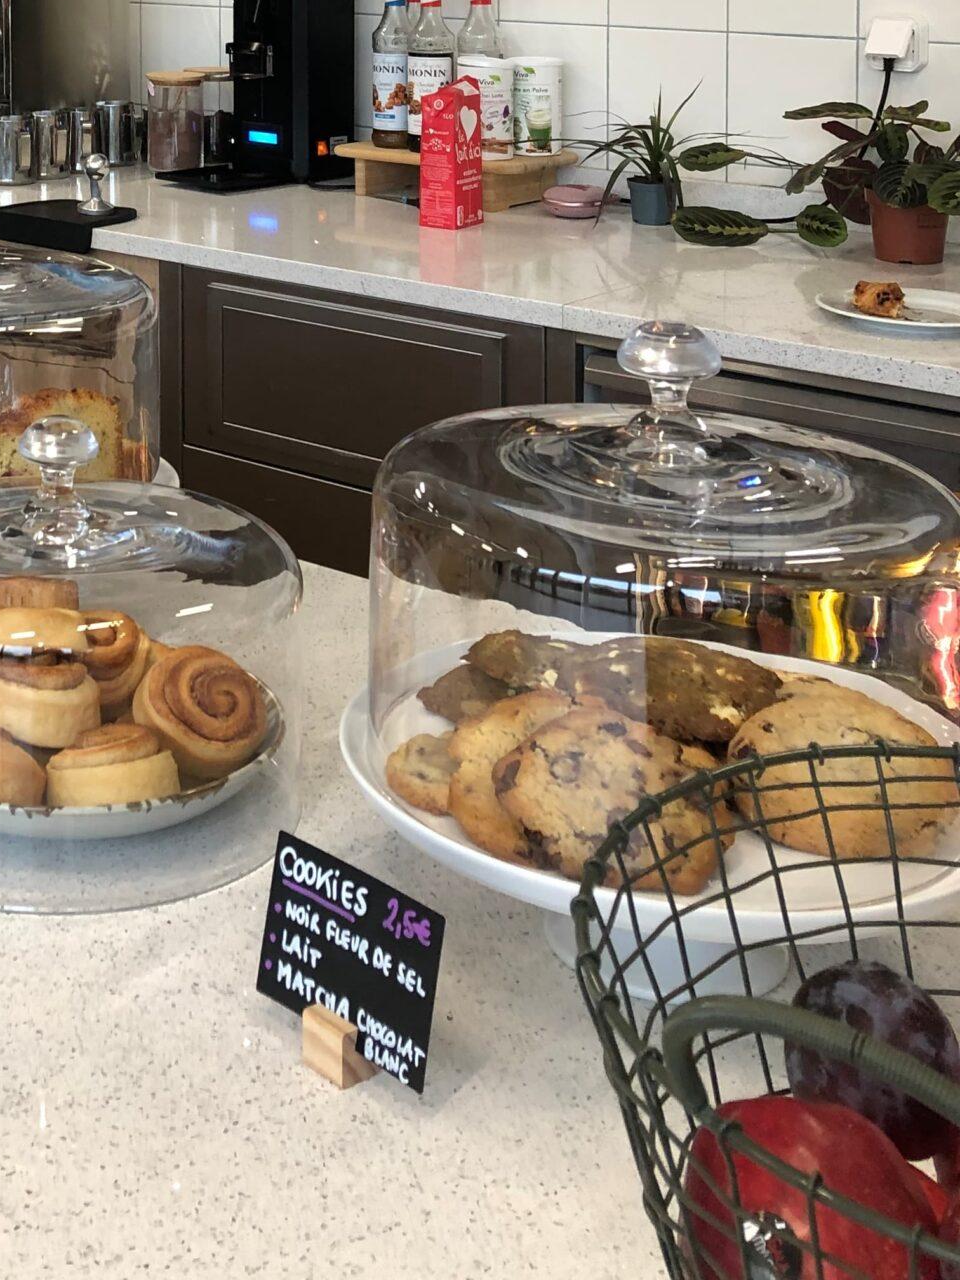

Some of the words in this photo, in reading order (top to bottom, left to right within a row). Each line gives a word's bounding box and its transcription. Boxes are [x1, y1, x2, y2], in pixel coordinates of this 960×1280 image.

[382, 897, 431, 947] 2,5€
[326, 919, 370, 965] FLEUR
[372, 945, 393, 977] DE
[396, 961, 426, 998] SEL
[277, 959, 350, 1021] MATCHA
[356, 1007, 427, 1068] CHOCOLAT
[363, 1037, 410, 1085] BLANC
